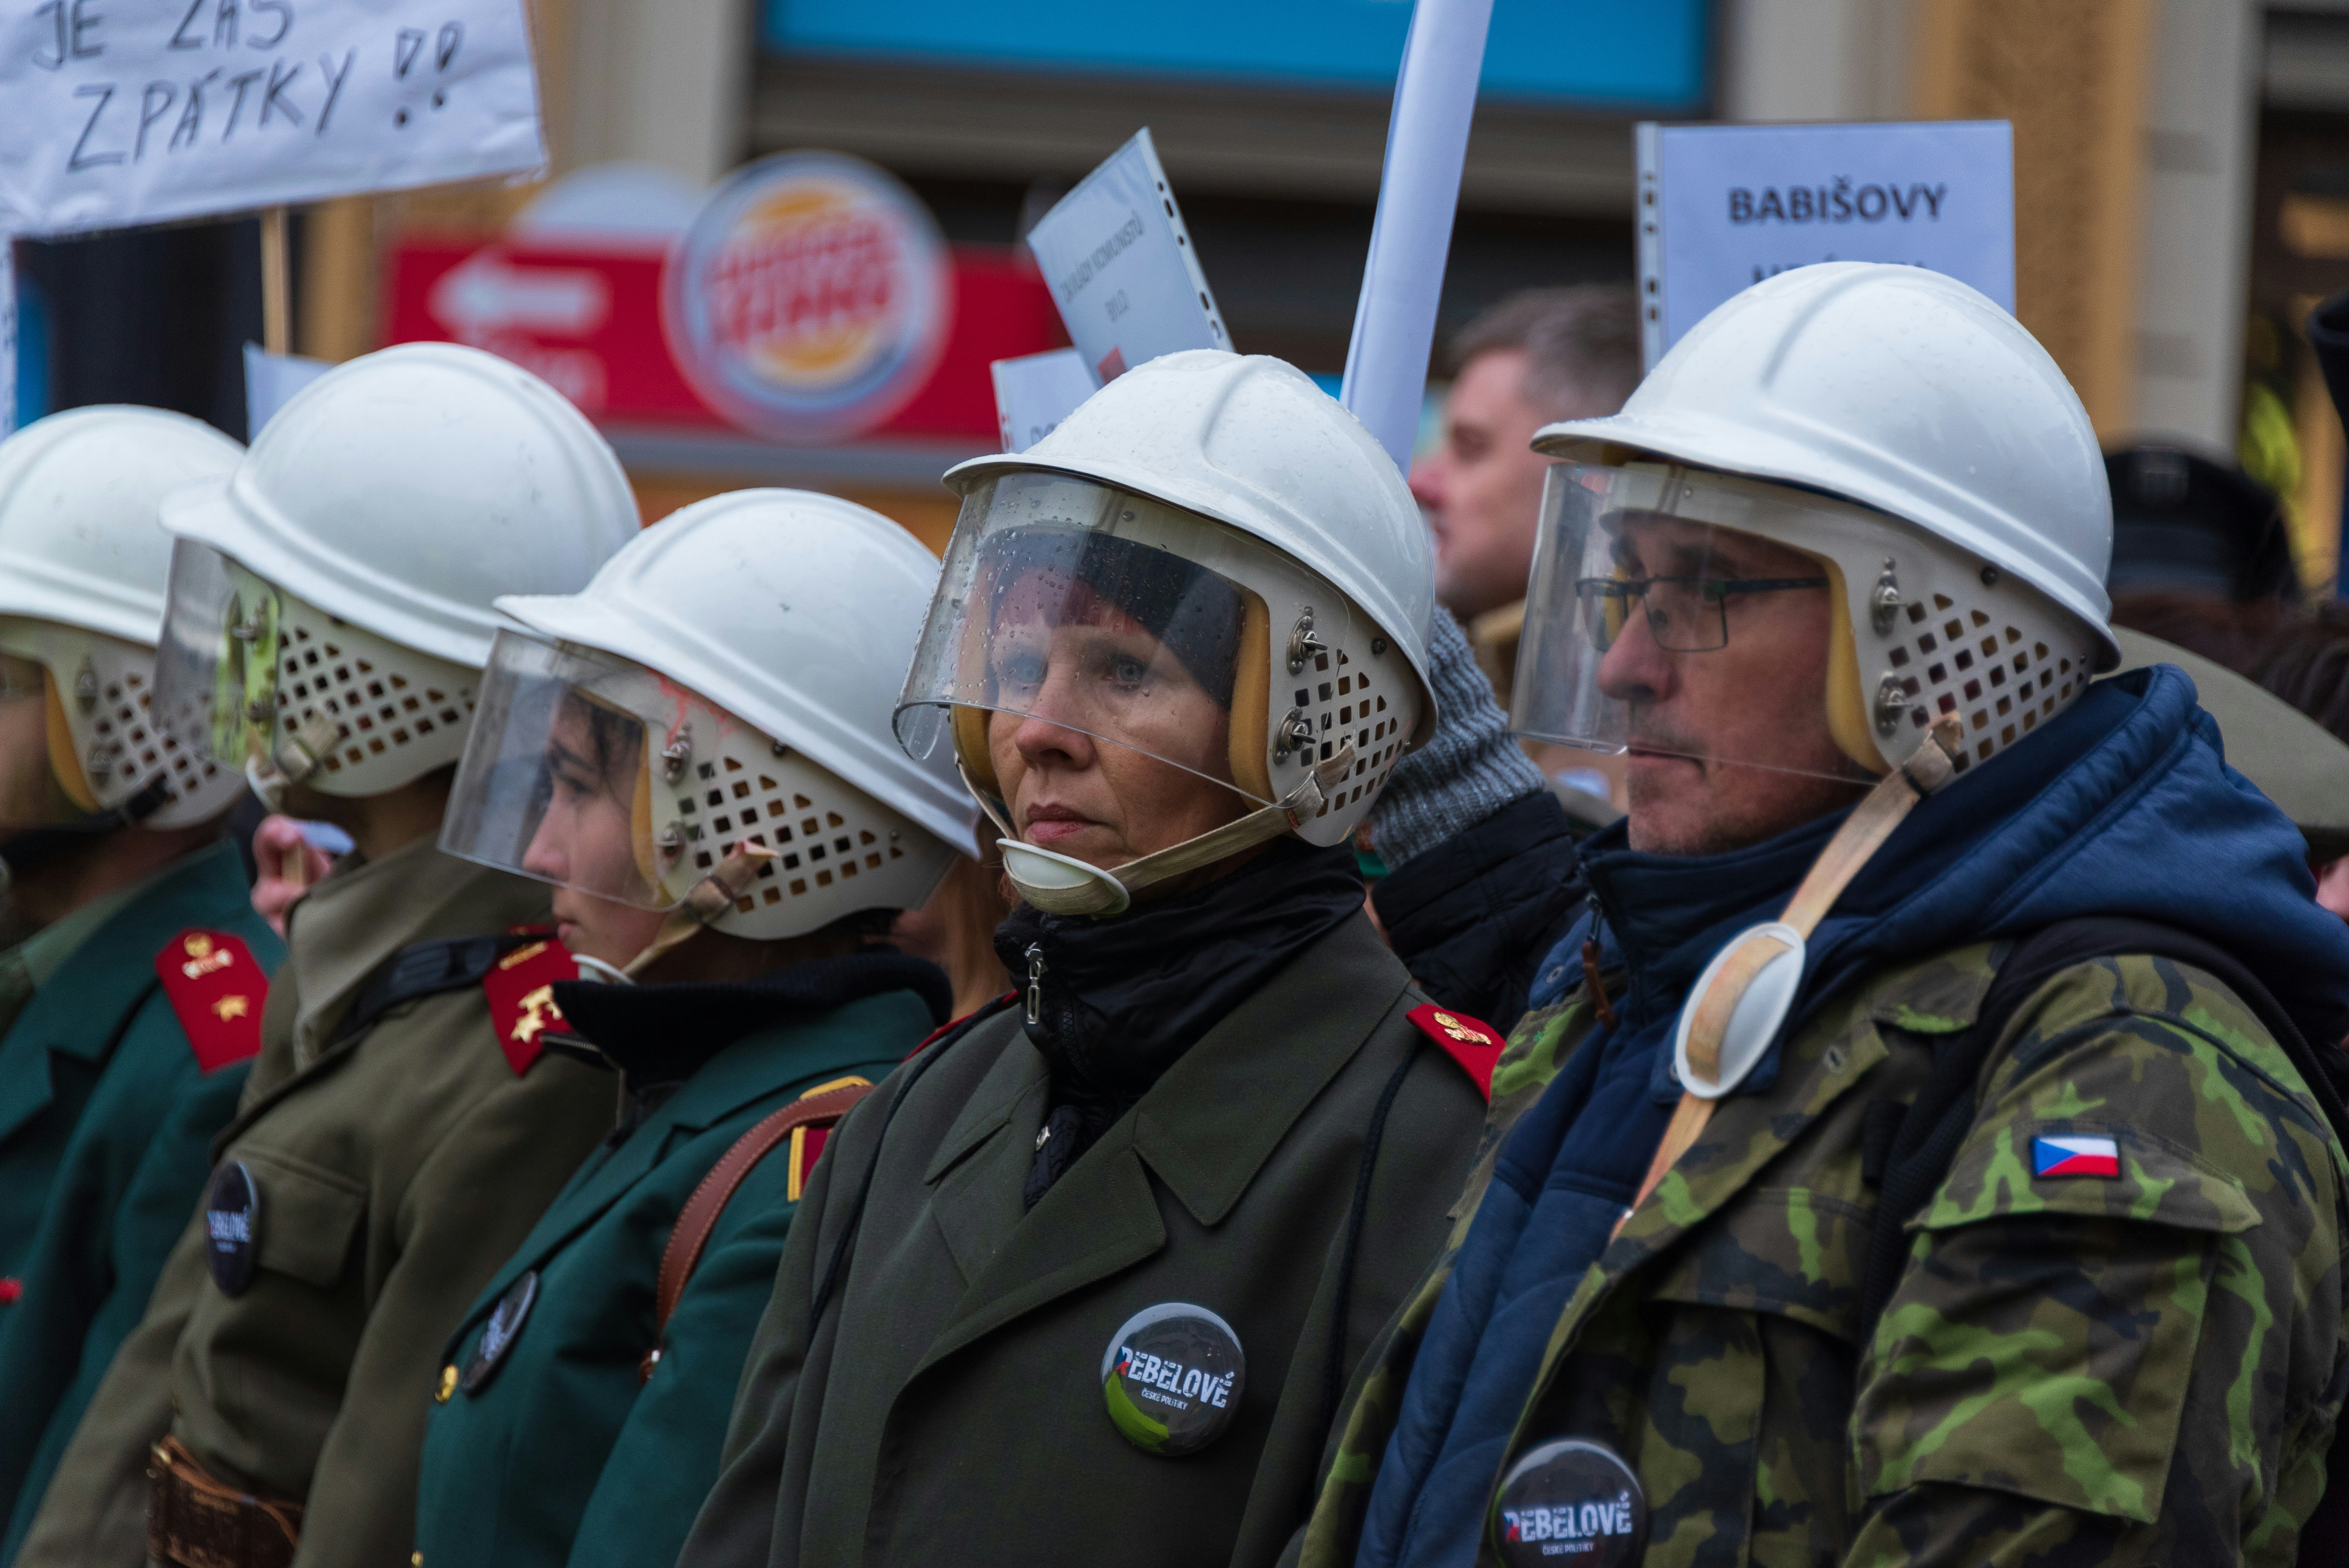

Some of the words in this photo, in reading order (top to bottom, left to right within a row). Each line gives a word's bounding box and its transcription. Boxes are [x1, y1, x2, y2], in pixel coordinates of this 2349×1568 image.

[32, 0, 109, 71] JE
[1728, 174, 1948, 225] BABIŠOVY
[1116, 1345, 1235, 1409] REBELOVÉ
[1141, 1387, 1161, 1402] ČESKÉ
[1160, 1394, 1188, 1410] POLITIKY
[1503, 1490, 1633, 1543] REBELOVÉ
